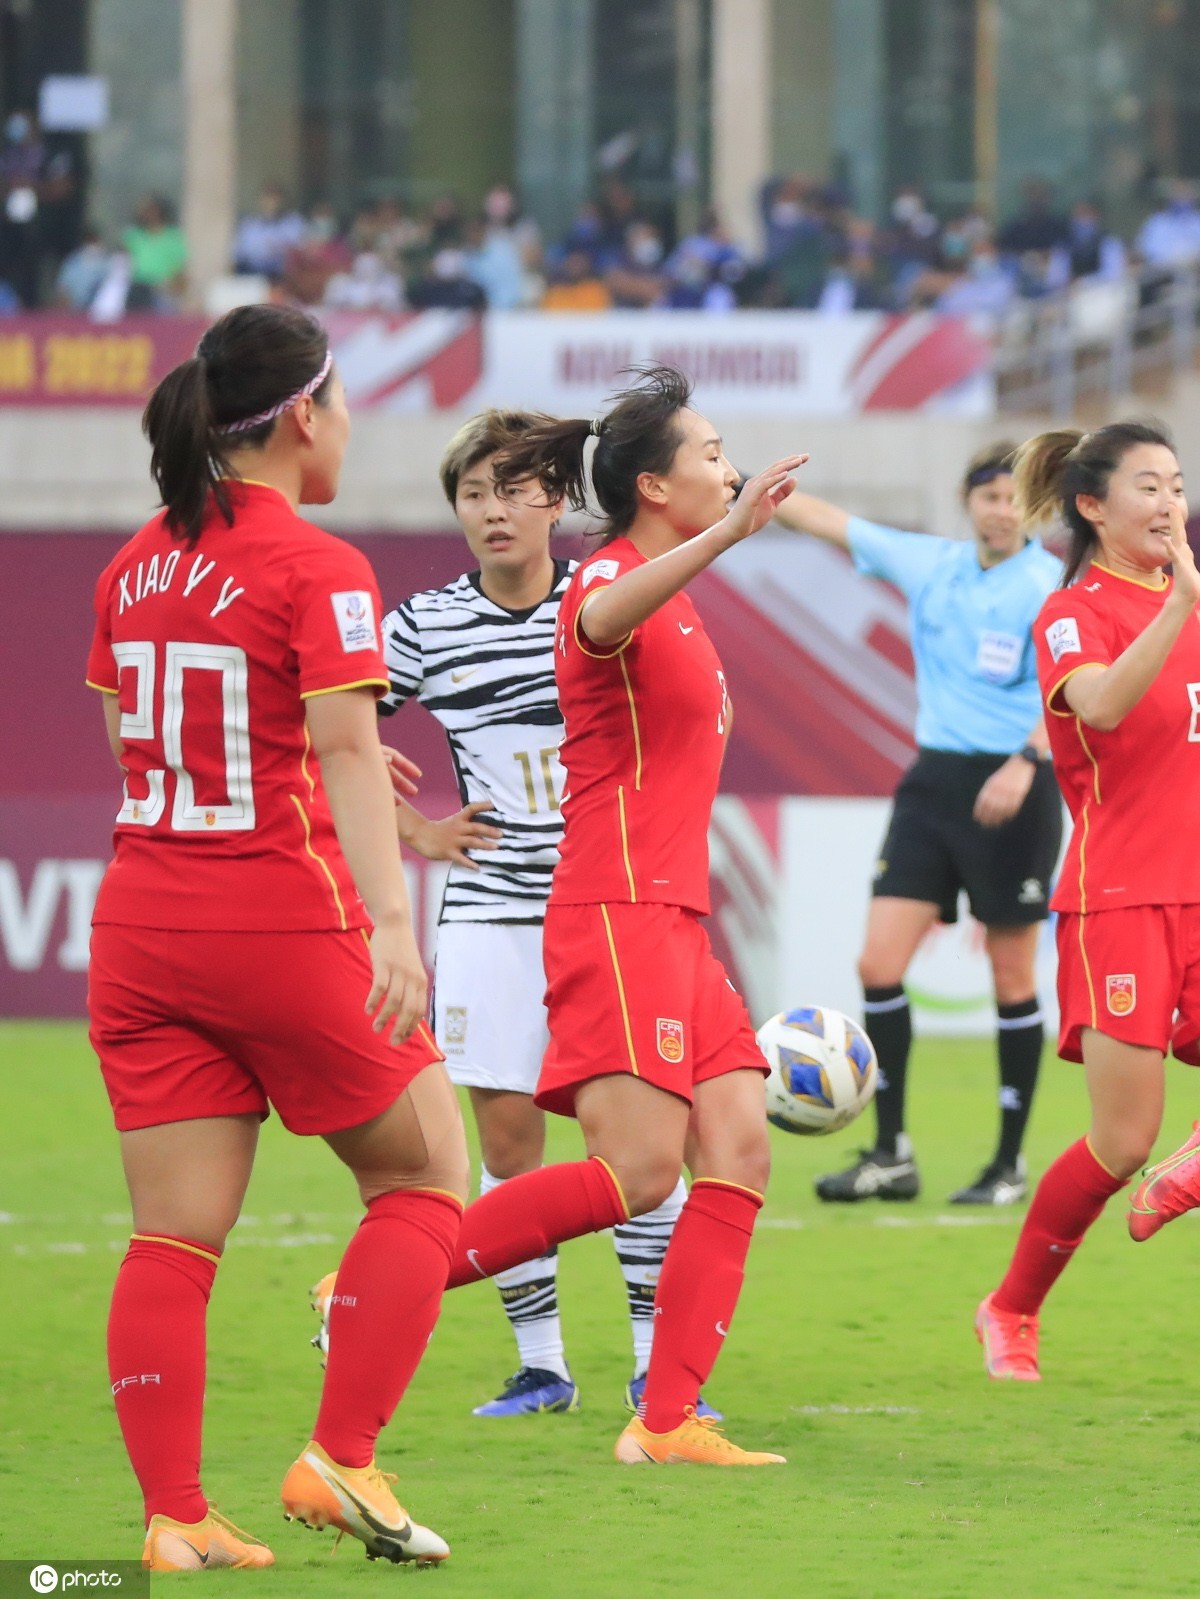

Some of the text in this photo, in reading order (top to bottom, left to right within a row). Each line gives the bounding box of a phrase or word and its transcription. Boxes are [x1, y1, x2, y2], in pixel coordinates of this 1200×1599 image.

[118, 549, 182, 616] XIAO
[111, 641, 256, 831] 20
[111, 1374, 161, 1396] CFA
